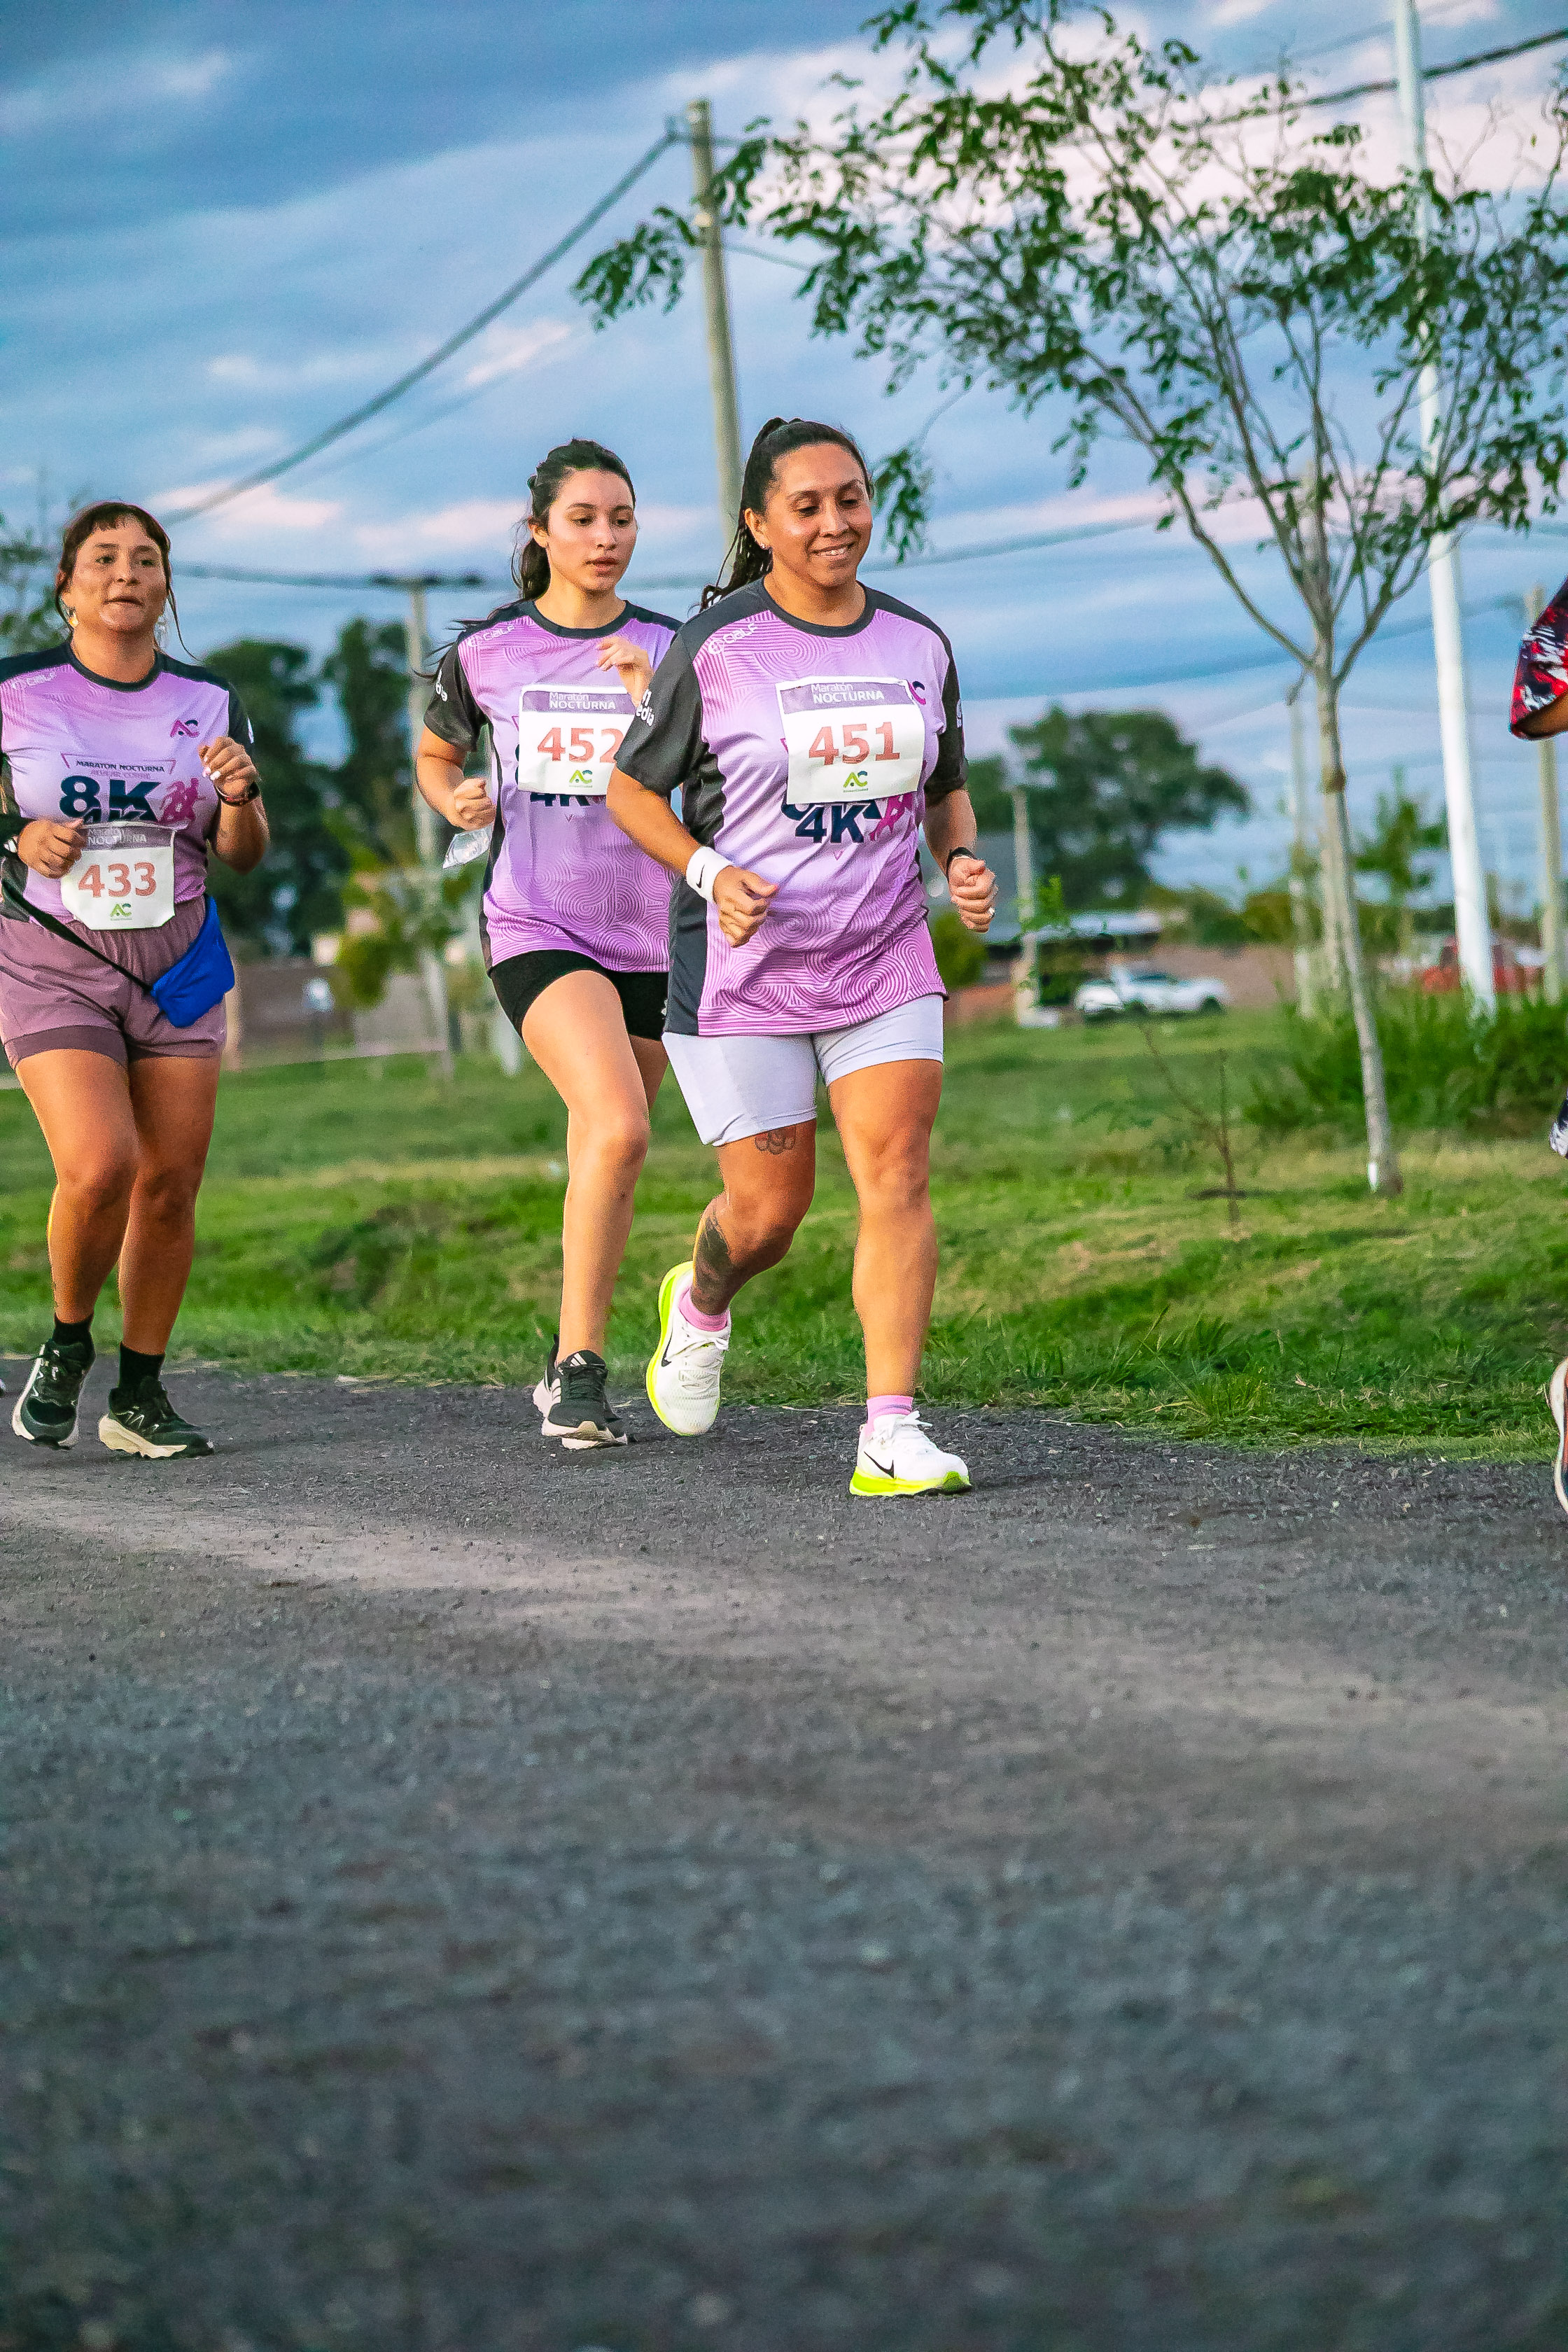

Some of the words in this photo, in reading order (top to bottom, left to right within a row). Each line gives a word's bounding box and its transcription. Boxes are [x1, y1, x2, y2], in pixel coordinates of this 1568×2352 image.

[549, 692, 589, 701] Maratón
[813, 690, 885, 704] NOCTURNA
[550, 700, 616, 710] NOCTURNA
[537, 727, 624, 763] 452
[808, 722, 900, 766] 451
[119, 764, 165, 773] NOCTURNA
[569, 769, 593, 784] AC
[843, 771, 868, 788] AC
[59, 775, 162, 822] 8K
[795, 804, 864, 844] 4K
[78, 862, 157, 898] 433
[110, 903, 132, 917] AC
